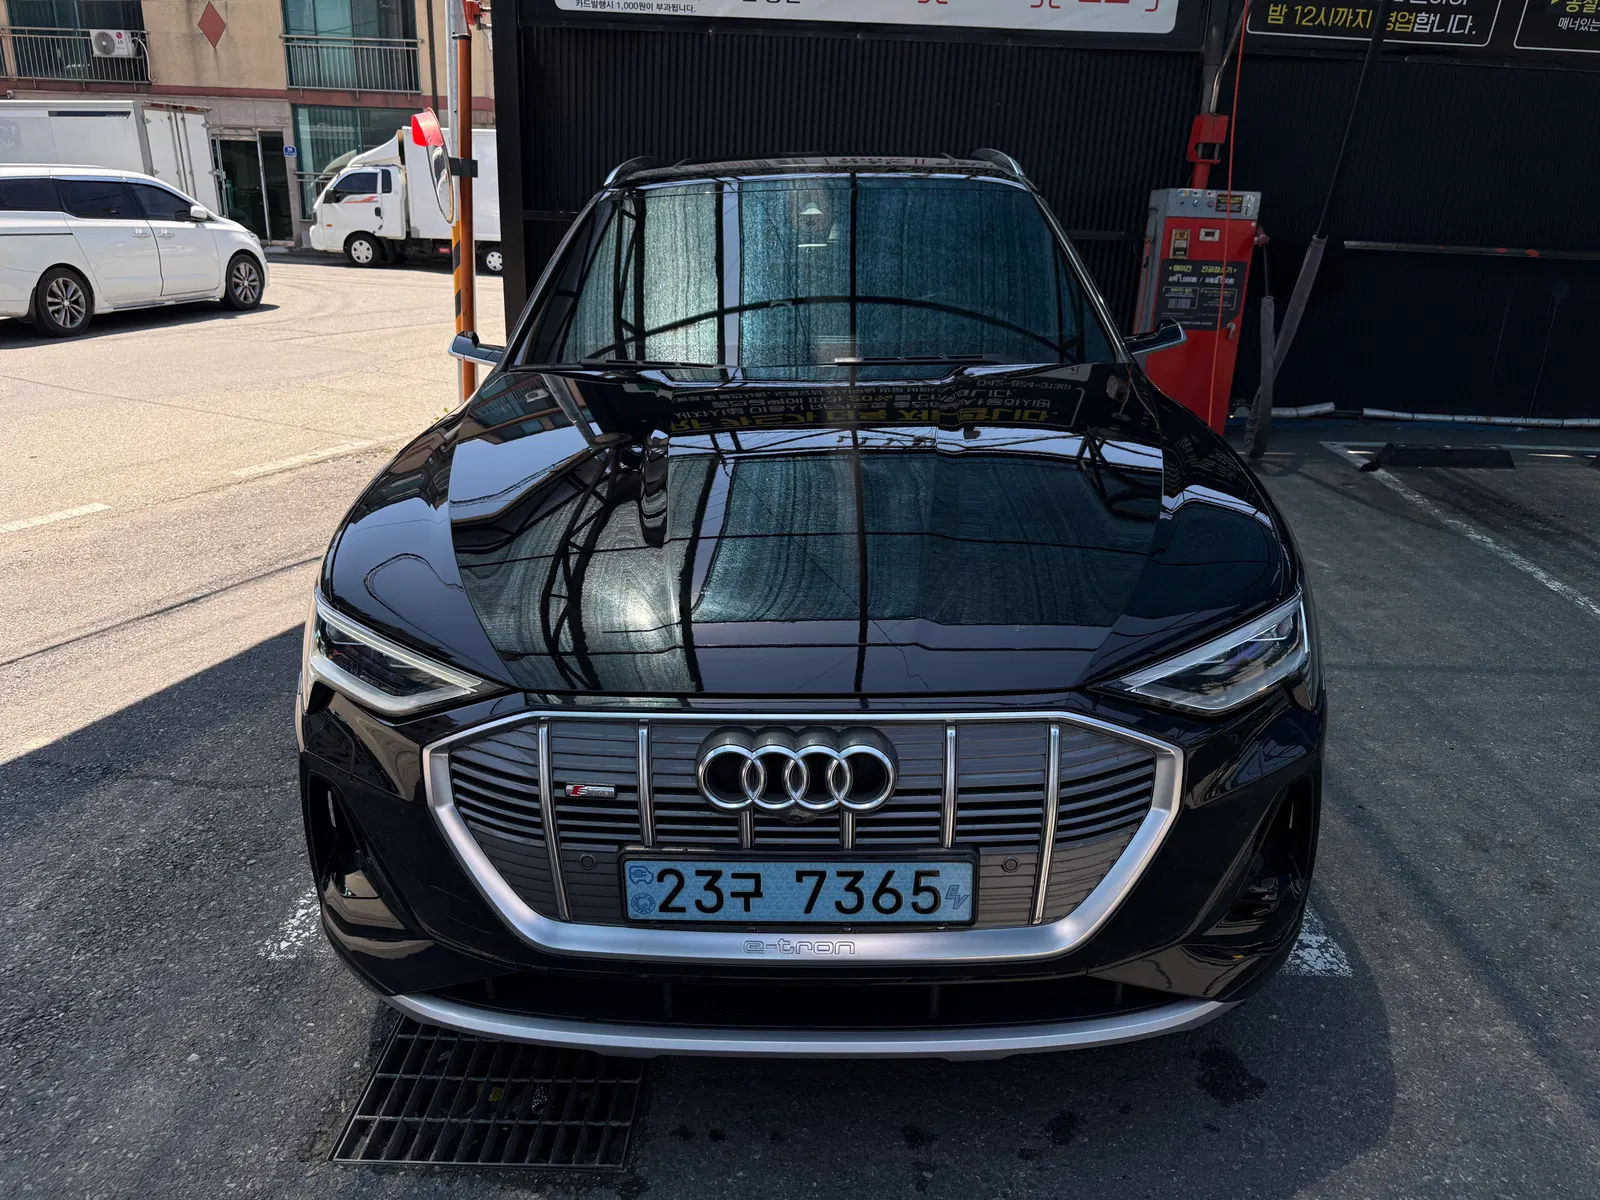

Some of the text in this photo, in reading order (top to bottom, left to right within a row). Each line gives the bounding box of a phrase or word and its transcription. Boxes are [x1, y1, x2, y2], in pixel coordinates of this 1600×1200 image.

[616, 2, 654, 11] 1,000원이
[656, 3, 696, 13] 부과됩니다.
[1267, 3, 1288, 25] 밤
[1294, 5, 1373, 29] 12시까지
[656, 868, 763, 913] 23구
[796, 870, 942, 914] 7365
[946, 884, 970, 910] EV
[743, 938, 856, 956] e-tron
